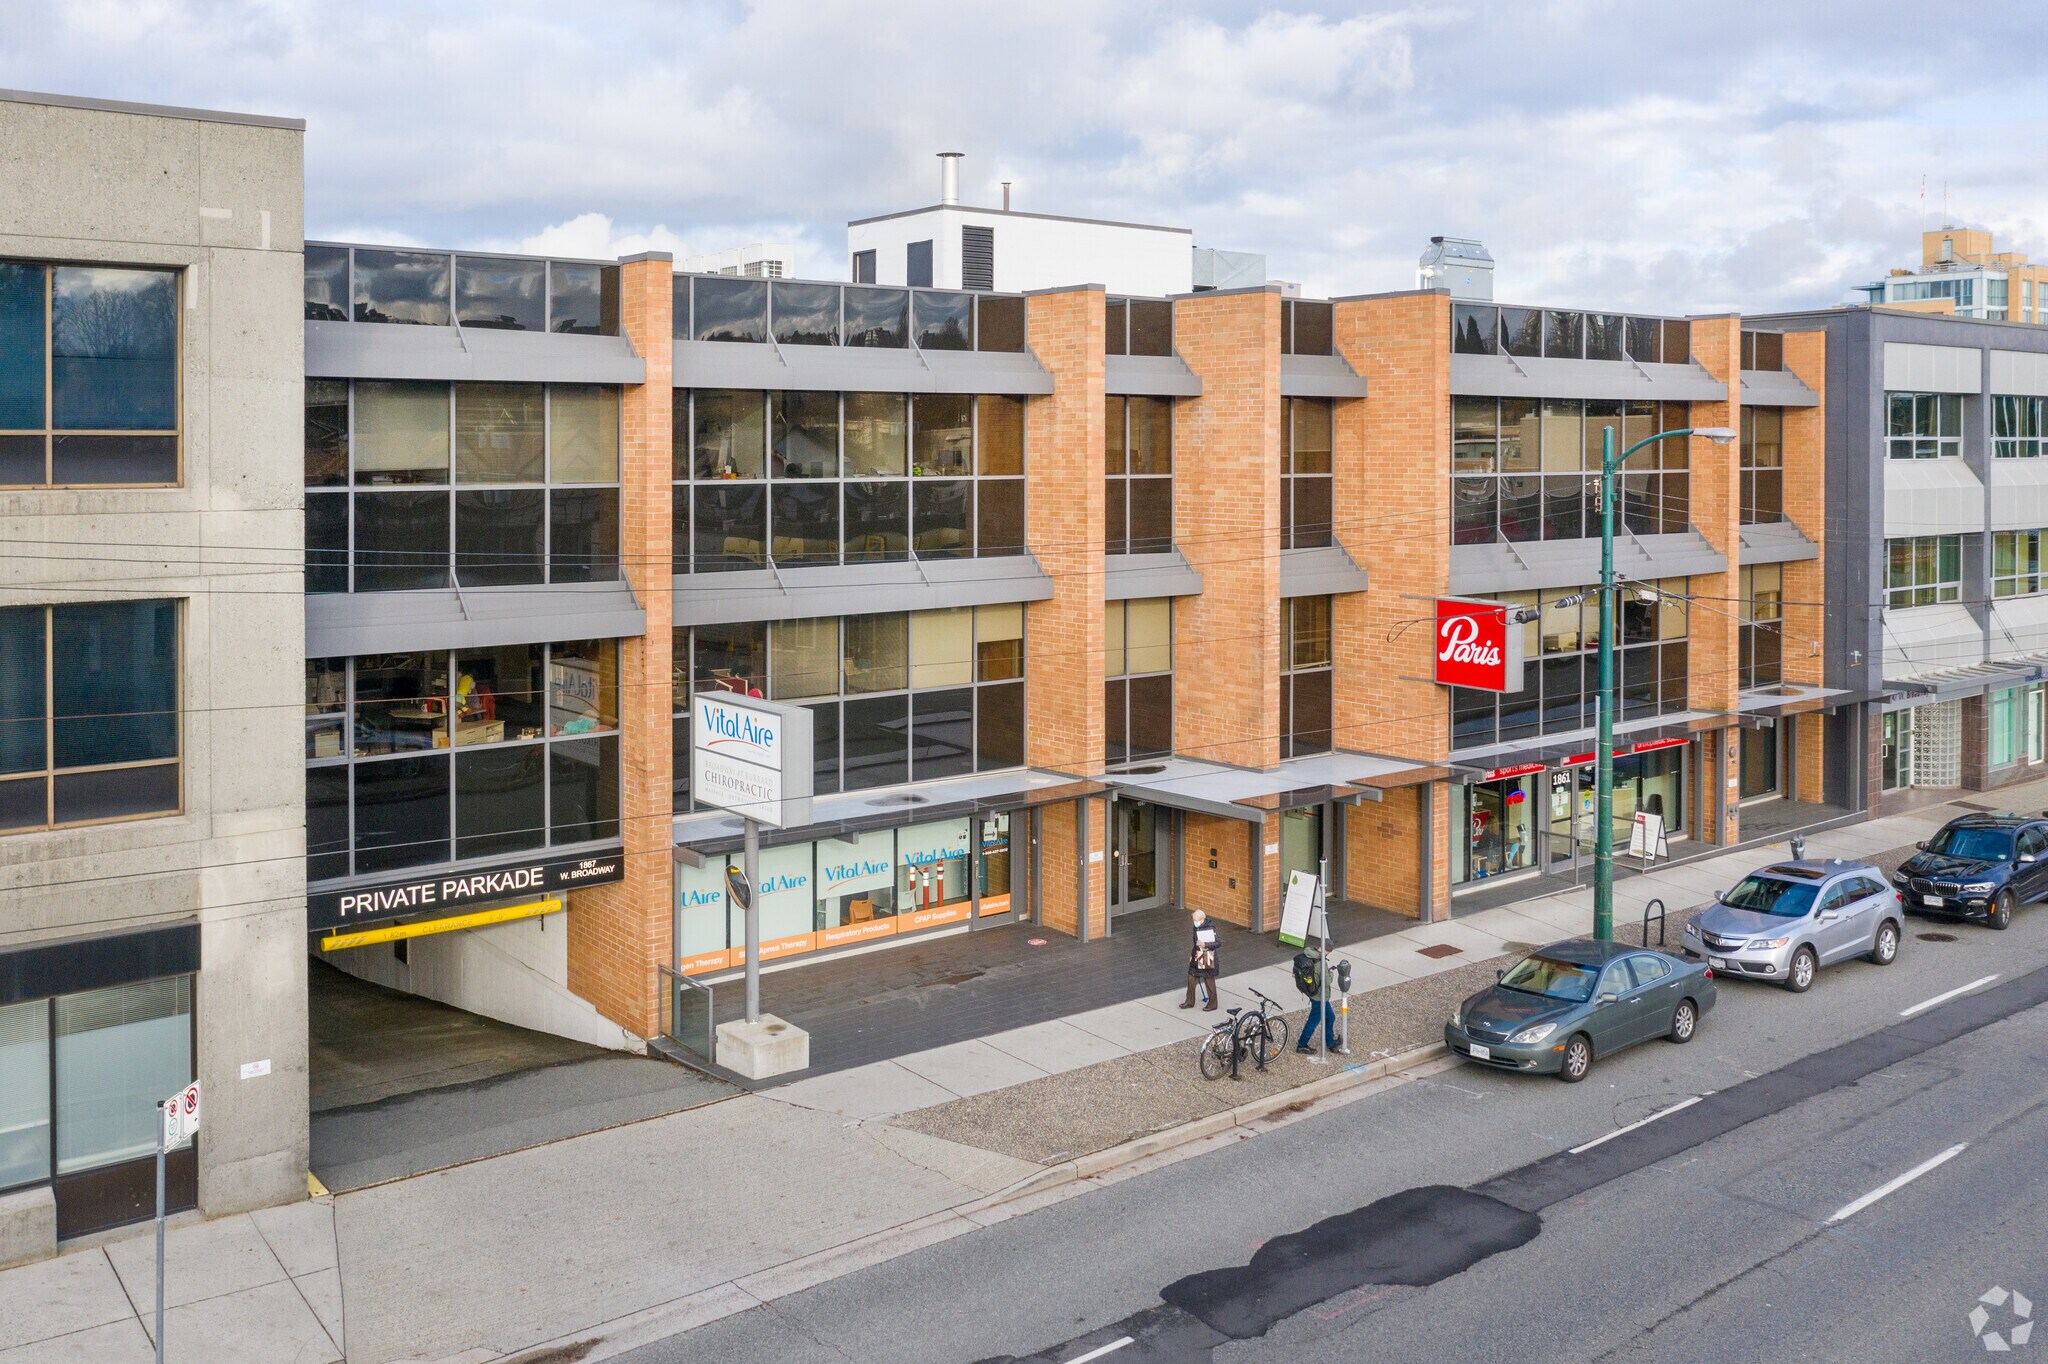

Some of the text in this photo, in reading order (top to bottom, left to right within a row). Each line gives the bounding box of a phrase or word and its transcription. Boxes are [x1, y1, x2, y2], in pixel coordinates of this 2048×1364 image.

[1439, 616, 1502, 666] Paris
[704, 705, 773, 747] VitalAire
[704, 770, 773, 801] CHIROPRACTIC
[1553, 773, 1570, 785] 1861
[579, 860, 596, 869] 1867
[905, 847, 965, 866] VitalAire
[571, 864, 615, 879] BROADWAY
[826, 859, 888, 881] VitalAire
[340, 867, 544, 916] PRIVATE PARKADE
[758, 873, 807, 893] alAire
[422, 918, 473, 934] CLEARANCE
[914, 914, 931, 925] CPAP
[931, 909, 957, 921] Supplies
[826, 923, 890, 942] Respiratory Products
[781, 939, 807, 950] Therapy
[696, 956, 723, 968] Therapy
